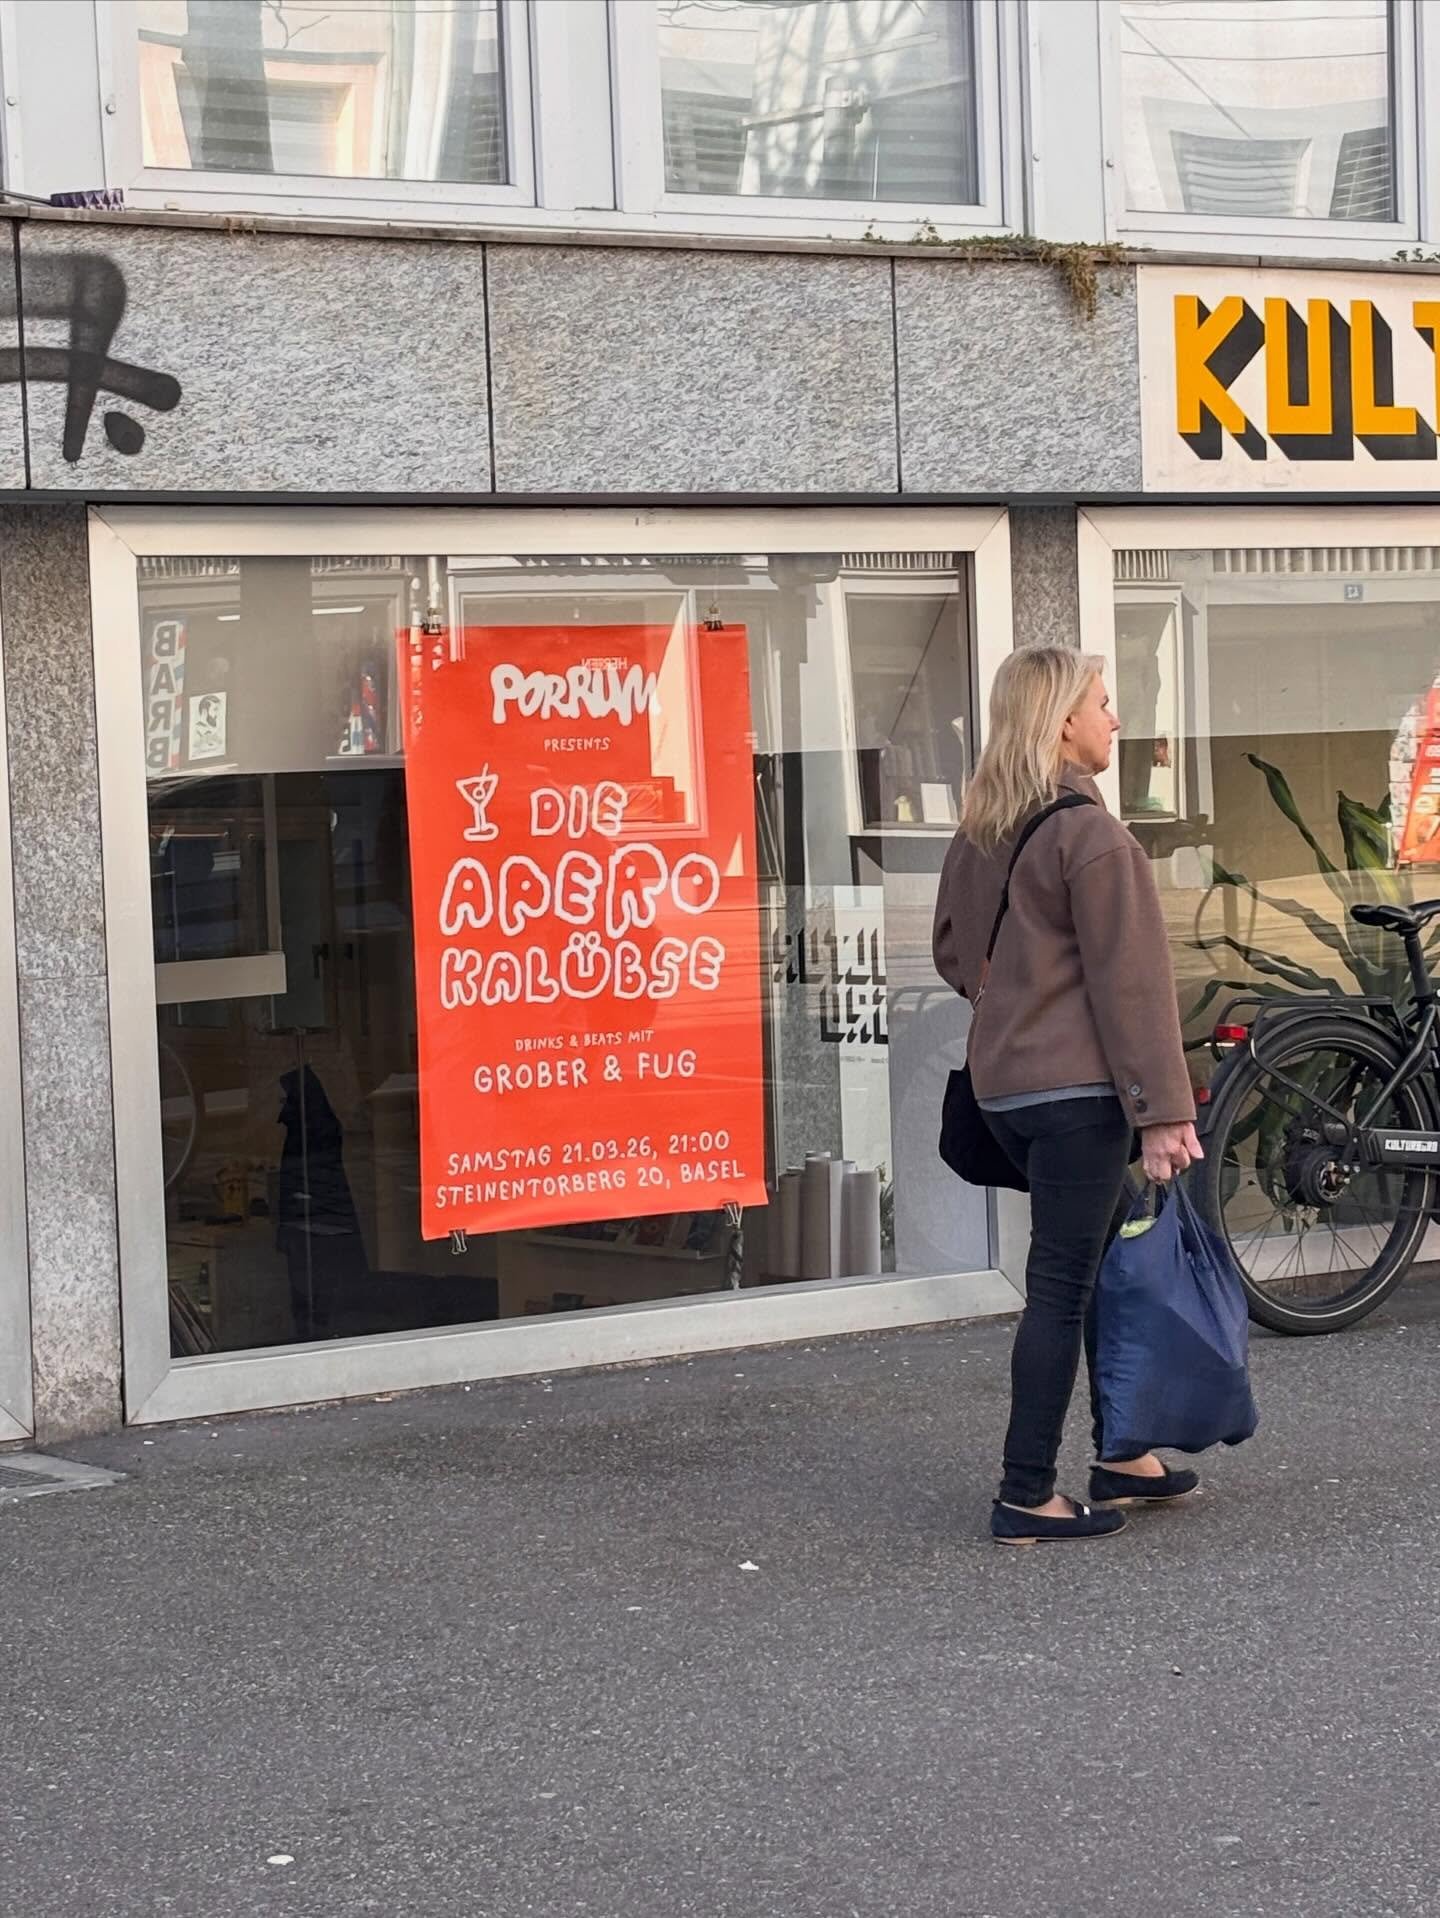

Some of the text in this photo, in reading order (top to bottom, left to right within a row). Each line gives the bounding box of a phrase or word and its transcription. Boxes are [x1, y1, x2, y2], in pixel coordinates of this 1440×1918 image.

[490, 664, 662, 726] PORRUM
[544, 737, 611, 752] PRESENTS
[530, 781, 628, 839] DIE
[439, 843, 720, 939] APERO
[440, 930, 726, 1009] KALÜBSE
[515, 1029, 655, 1052] DRINKS & BEATS MIT
[474, 1049, 697, 1094] GROBER & FUG
[448, 1130, 730, 1176] SAMSTAG 21.03.26, 21:00
[435, 1159, 745, 1209] STEINENTORBERG 20, BASEL
